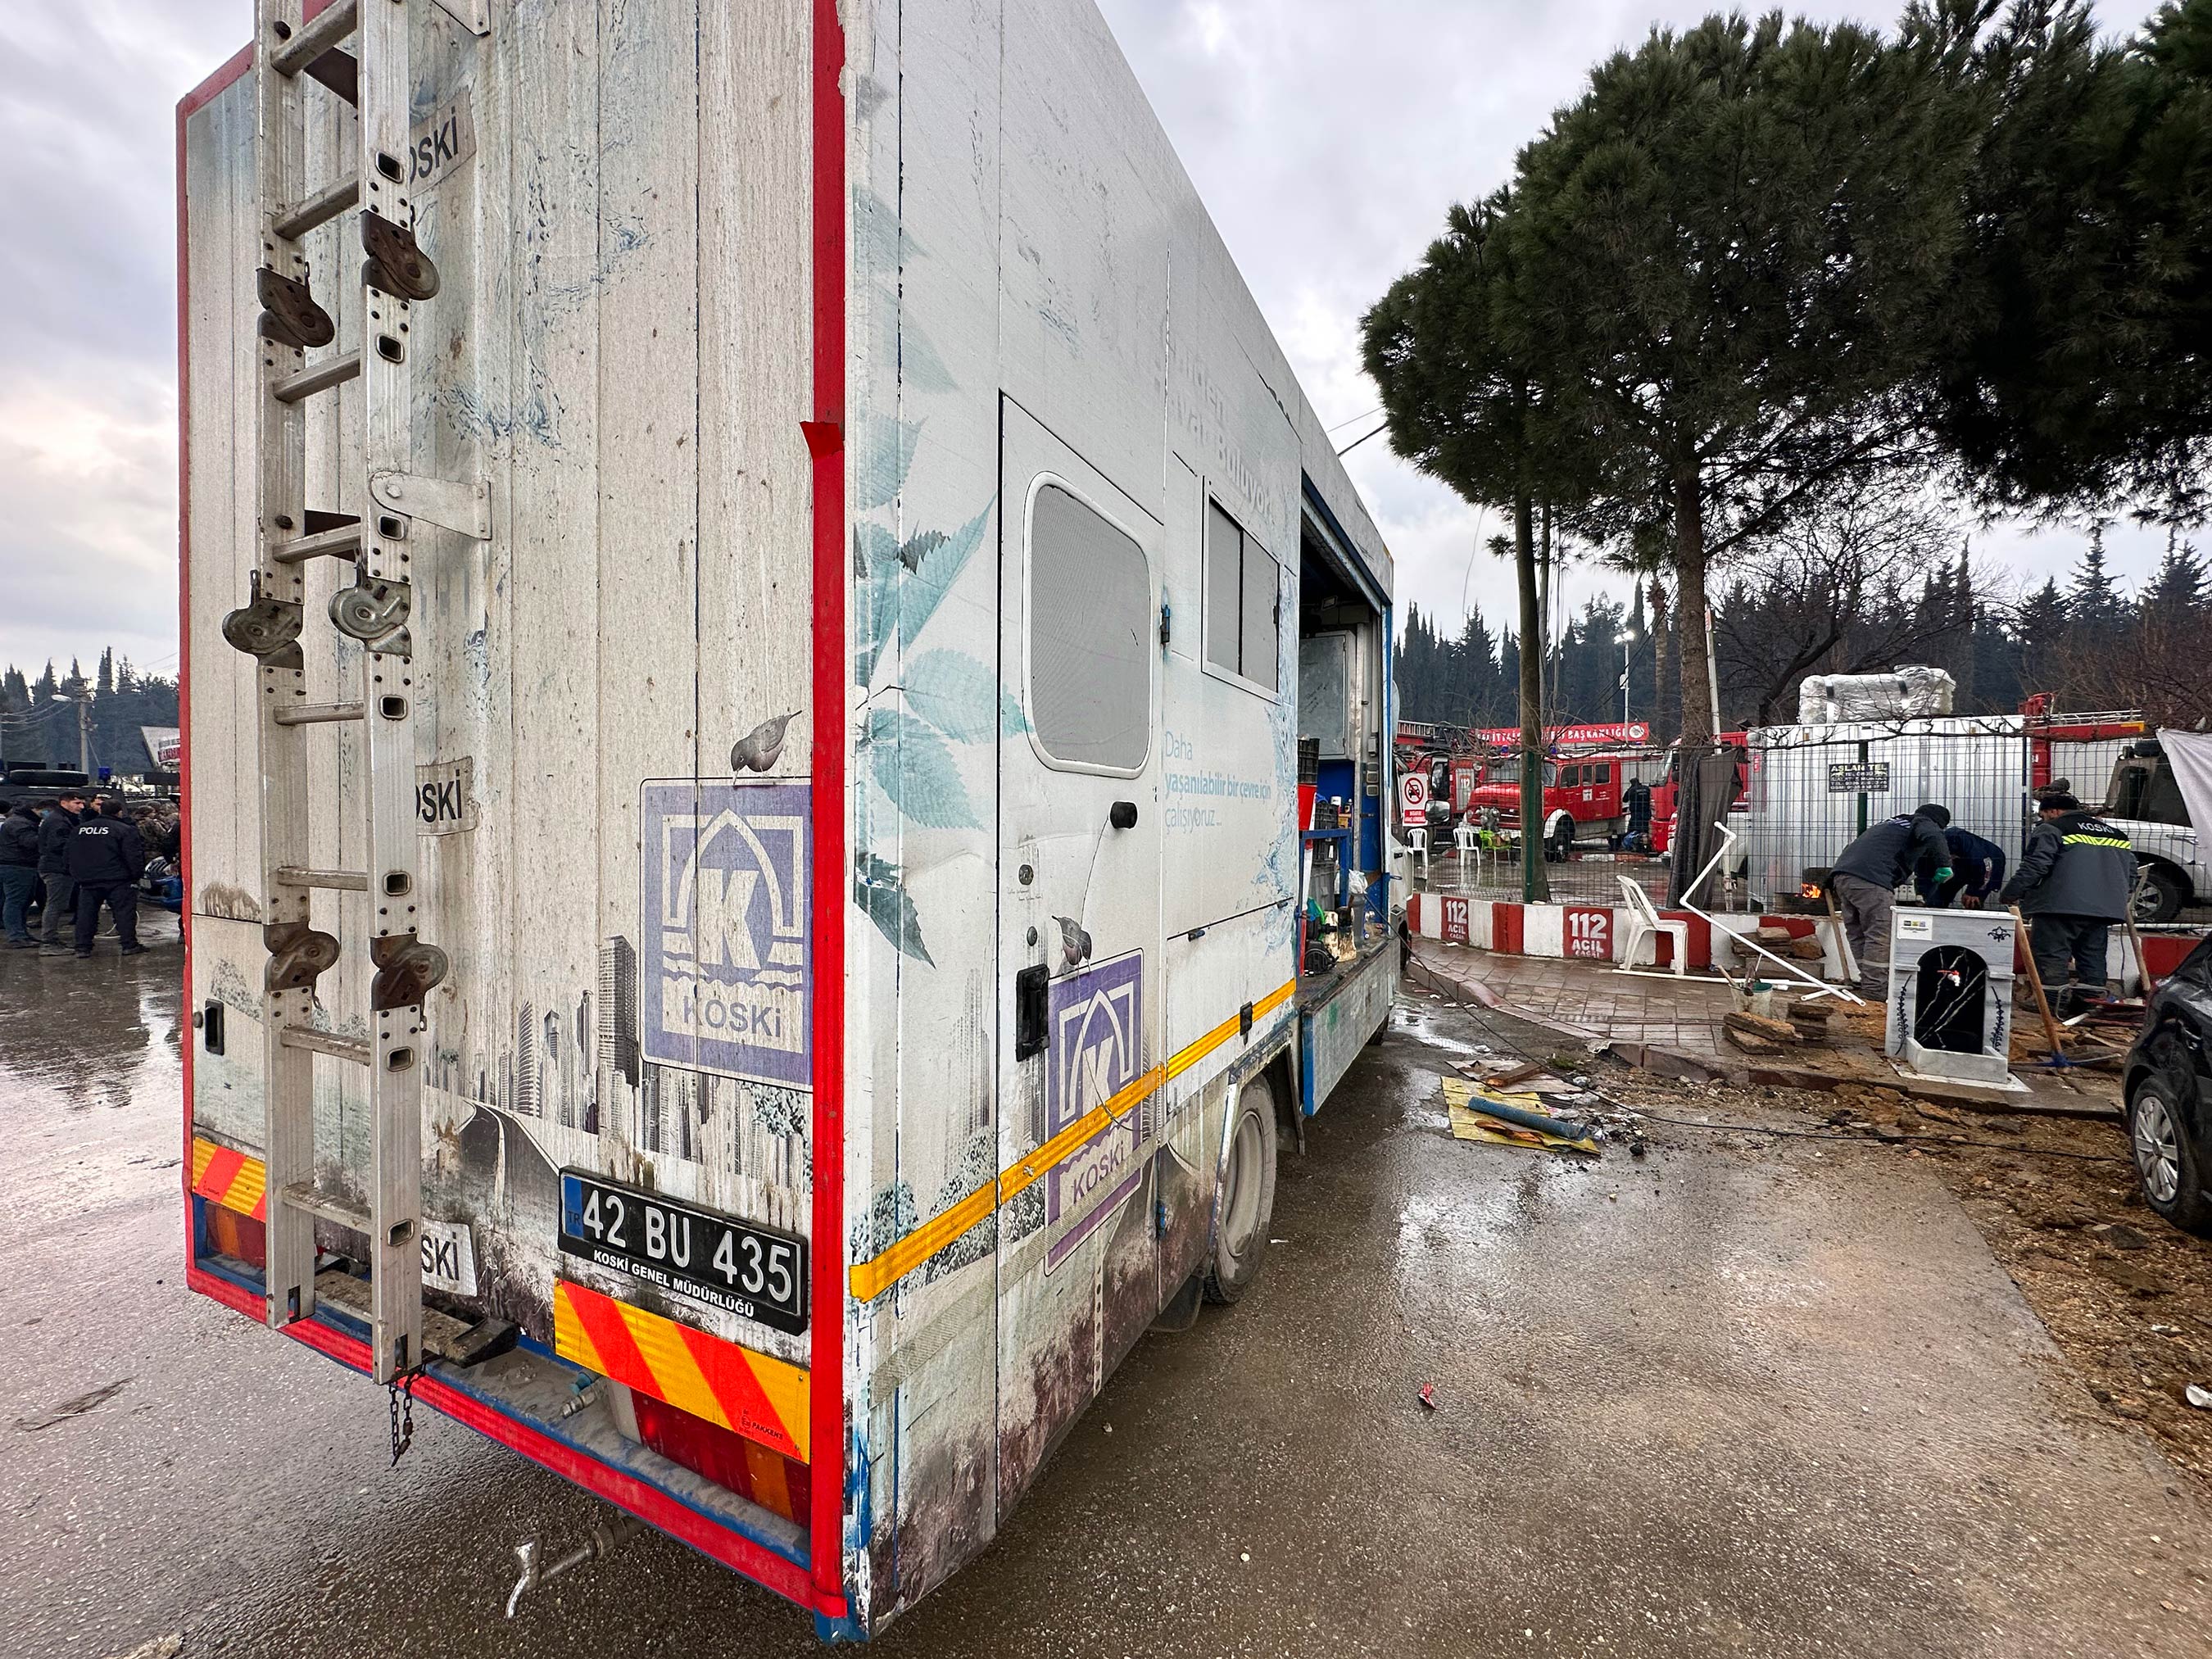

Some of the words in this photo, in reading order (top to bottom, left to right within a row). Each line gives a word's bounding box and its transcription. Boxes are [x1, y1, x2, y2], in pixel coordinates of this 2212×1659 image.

[1164, 730, 1193, 761] Daha
[1446, 900, 1467, 924] 112
[1569, 913, 1607, 940] 112
[568, 1210, 581, 1226] TR
[582, 1190, 626, 1249] 42
[645, 1205, 691, 1268] BU
[713, 1230, 791, 1303] 435
[593, 1249, 629, 1271] KOSKİ
[631, 1262, 670, 1288] GENEL
[673, 1276, 755, 1318] MÜDÜRLÜĞÜ
